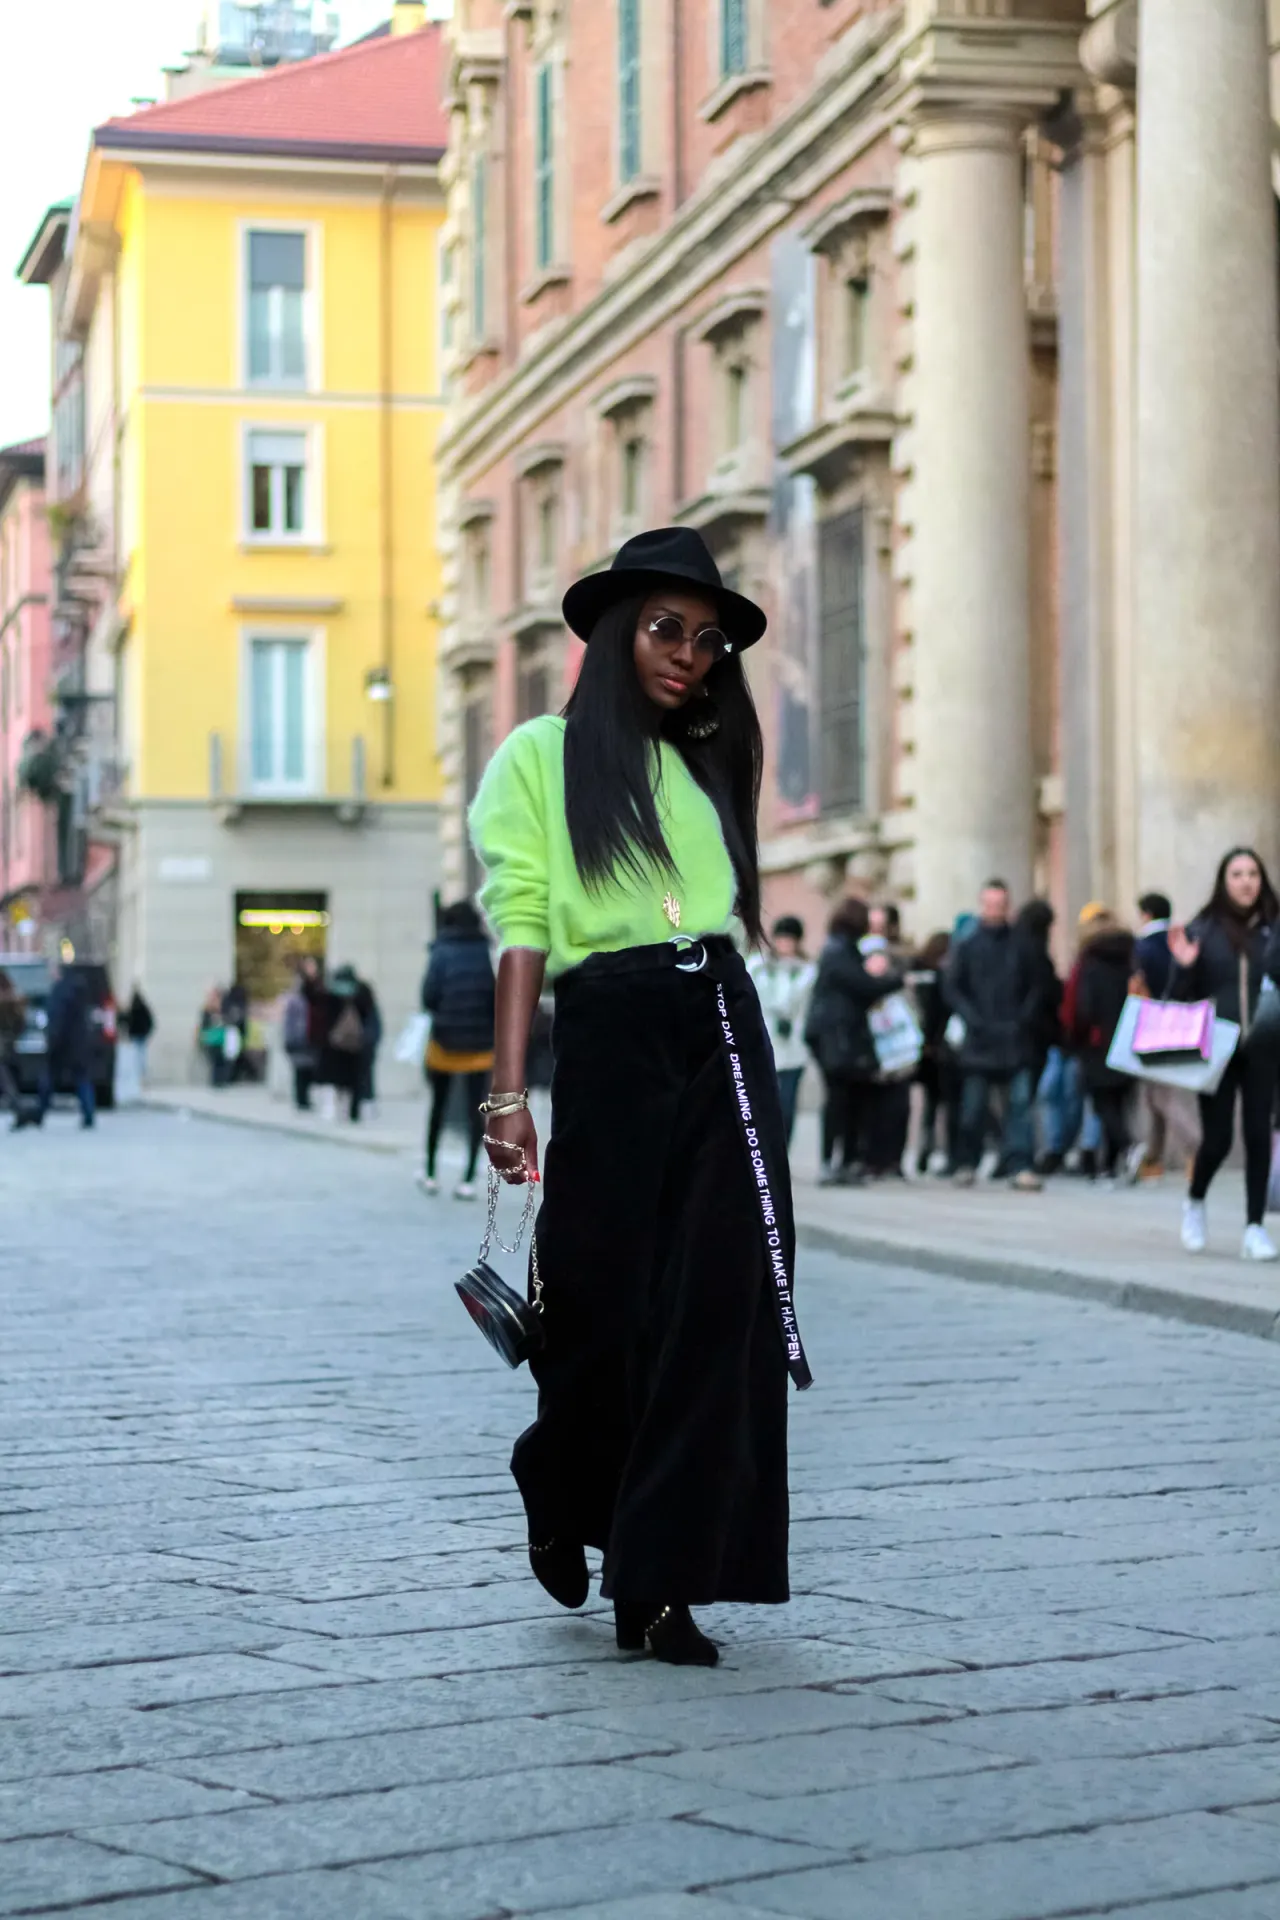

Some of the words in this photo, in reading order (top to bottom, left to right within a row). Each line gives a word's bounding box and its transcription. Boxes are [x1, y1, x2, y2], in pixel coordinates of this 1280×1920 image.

[717, 983, 727, 1018] STOP
[722, 1020, 736, 1046] DAY
[746, 1128, 759, 1148] DO
[751, 1149, 776, 1226] SOMETHING
[767, 1227, 780, 1247] TO
[770, 1249, 788, 1287] MAKE
[779, 1290, 791, 1303] IT
[781, 1306, 801, 1360] HAPPEN
